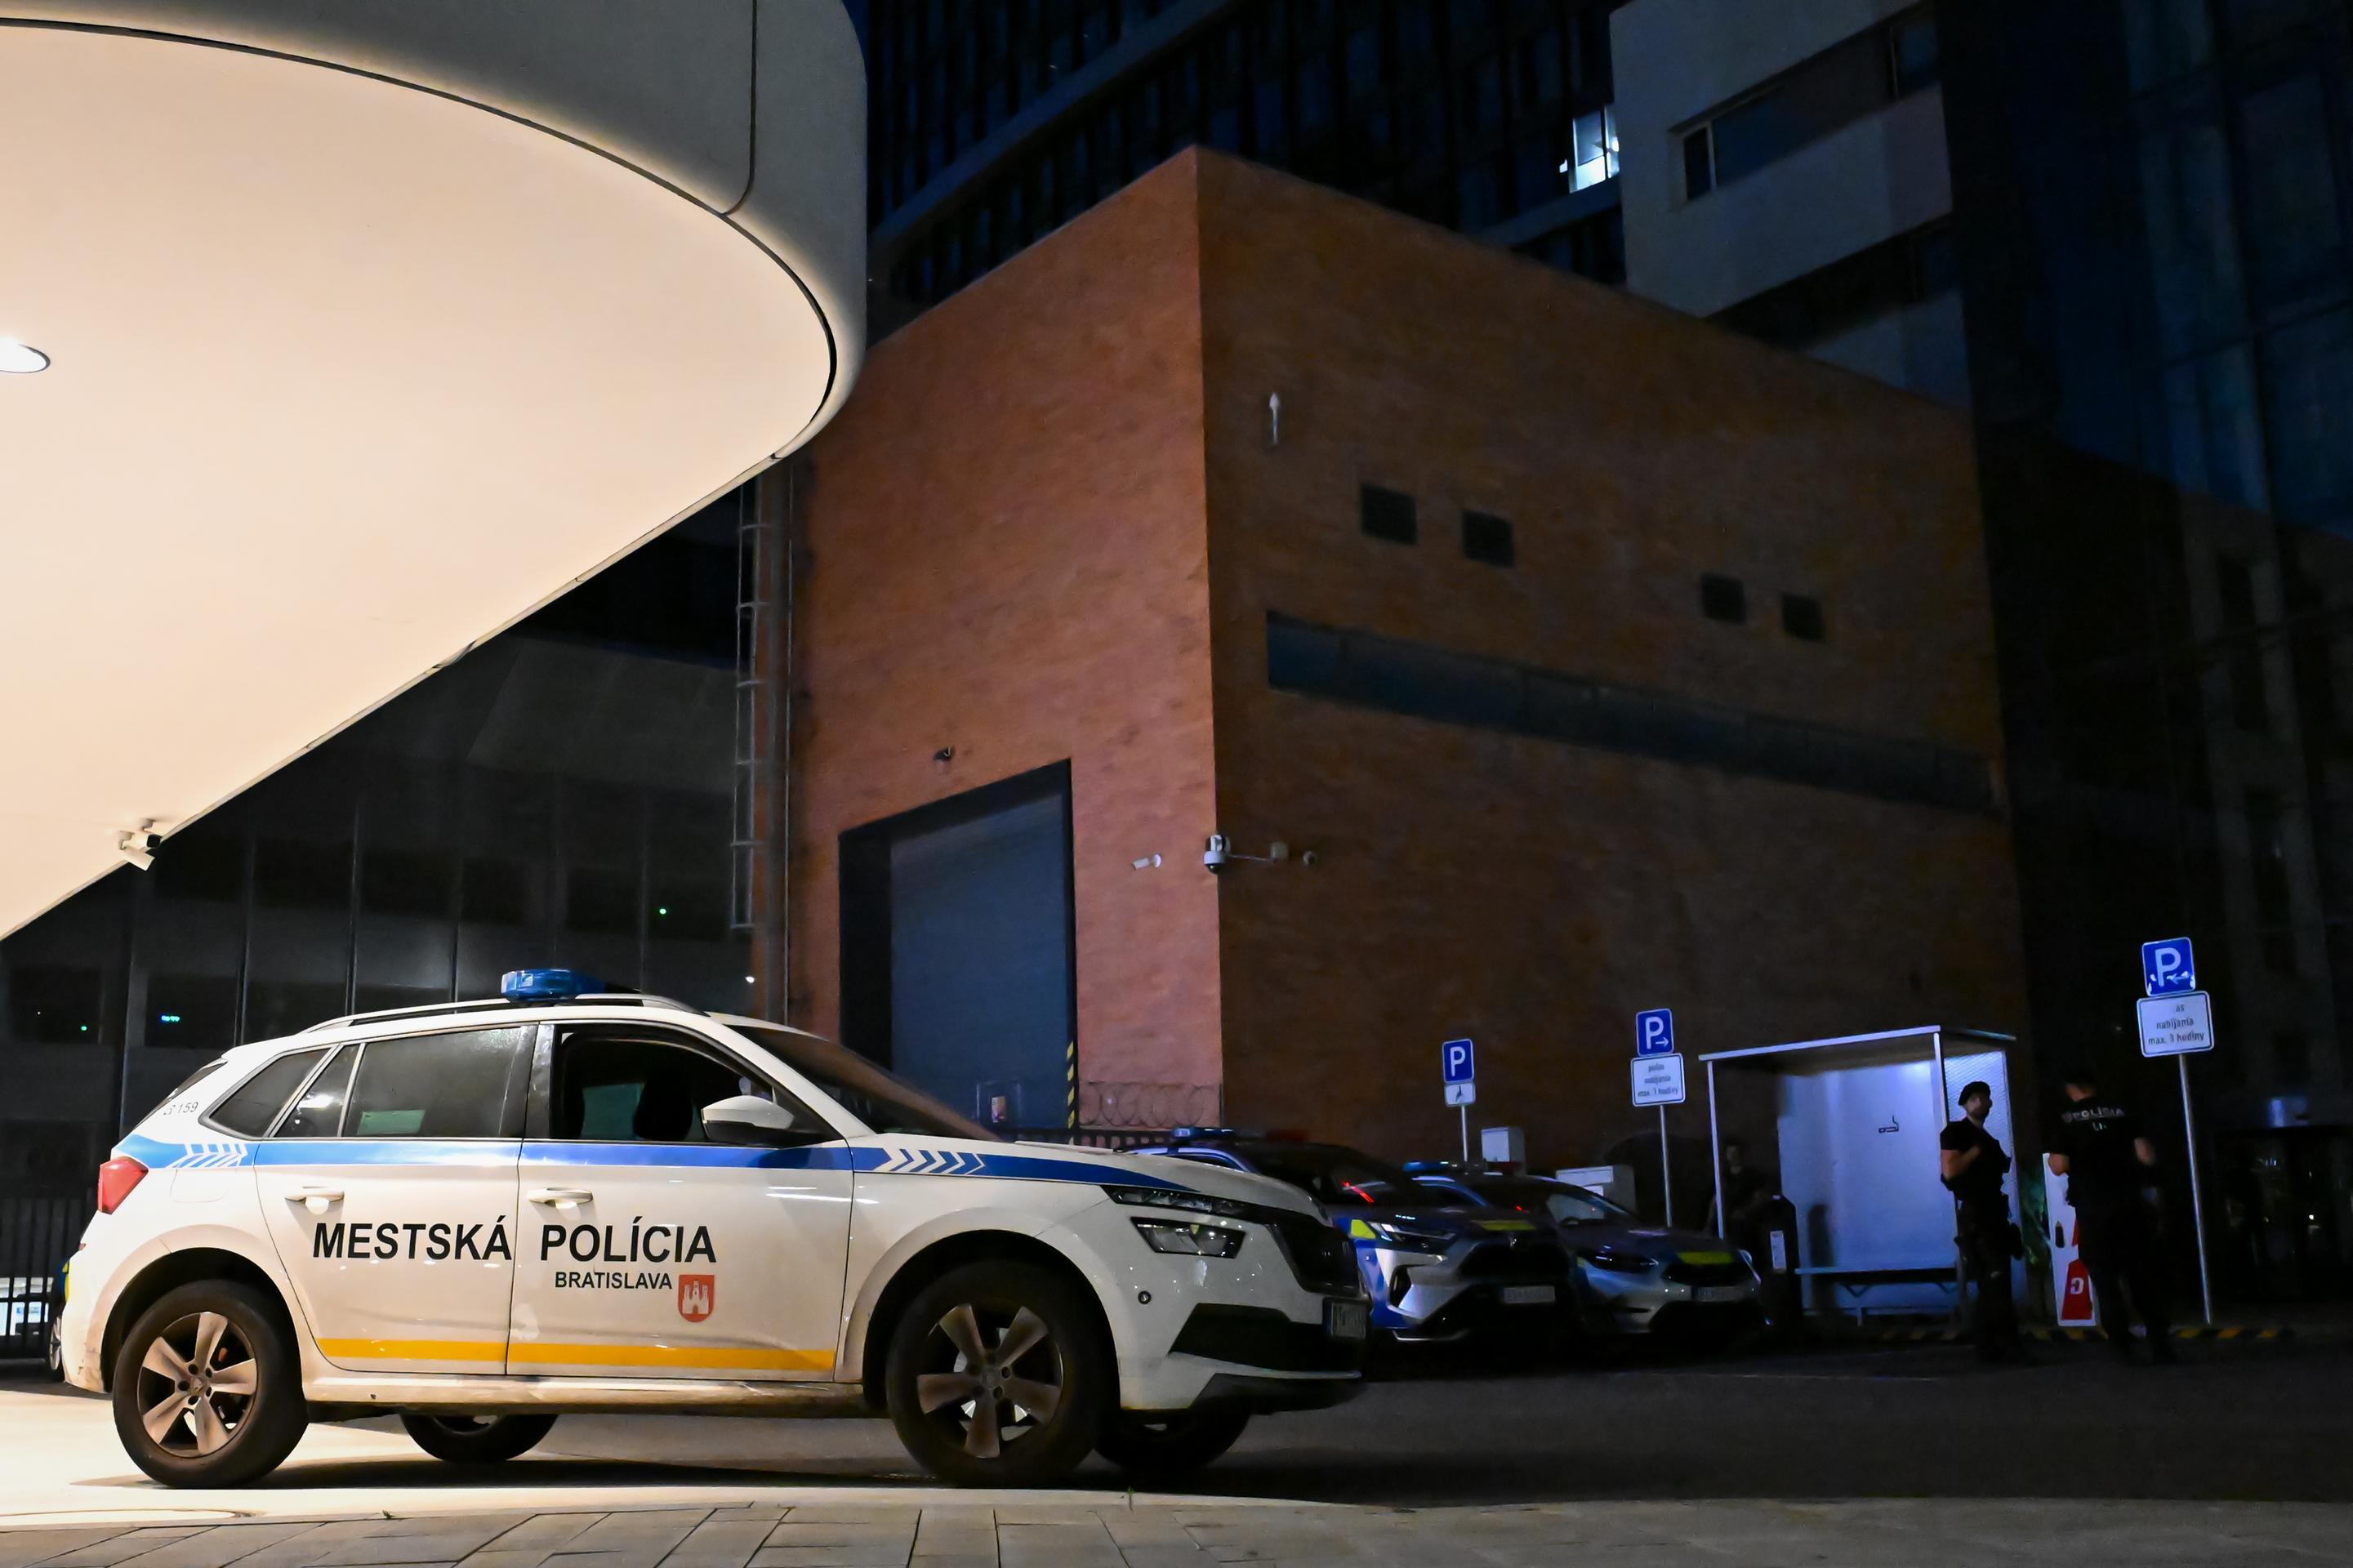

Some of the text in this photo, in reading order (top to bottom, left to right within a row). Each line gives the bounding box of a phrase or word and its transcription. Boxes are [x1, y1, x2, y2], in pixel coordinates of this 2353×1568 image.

[2155, 947, 2181, 987] P
[1646, 1016, 1664, 1049] P
[1450, 1046, 1466, 1076] P
[314, 1214, 717, 1263] MESTSKÁ POLÍCIA
[555, 1271, 673, 1290] BRATISLAVA
